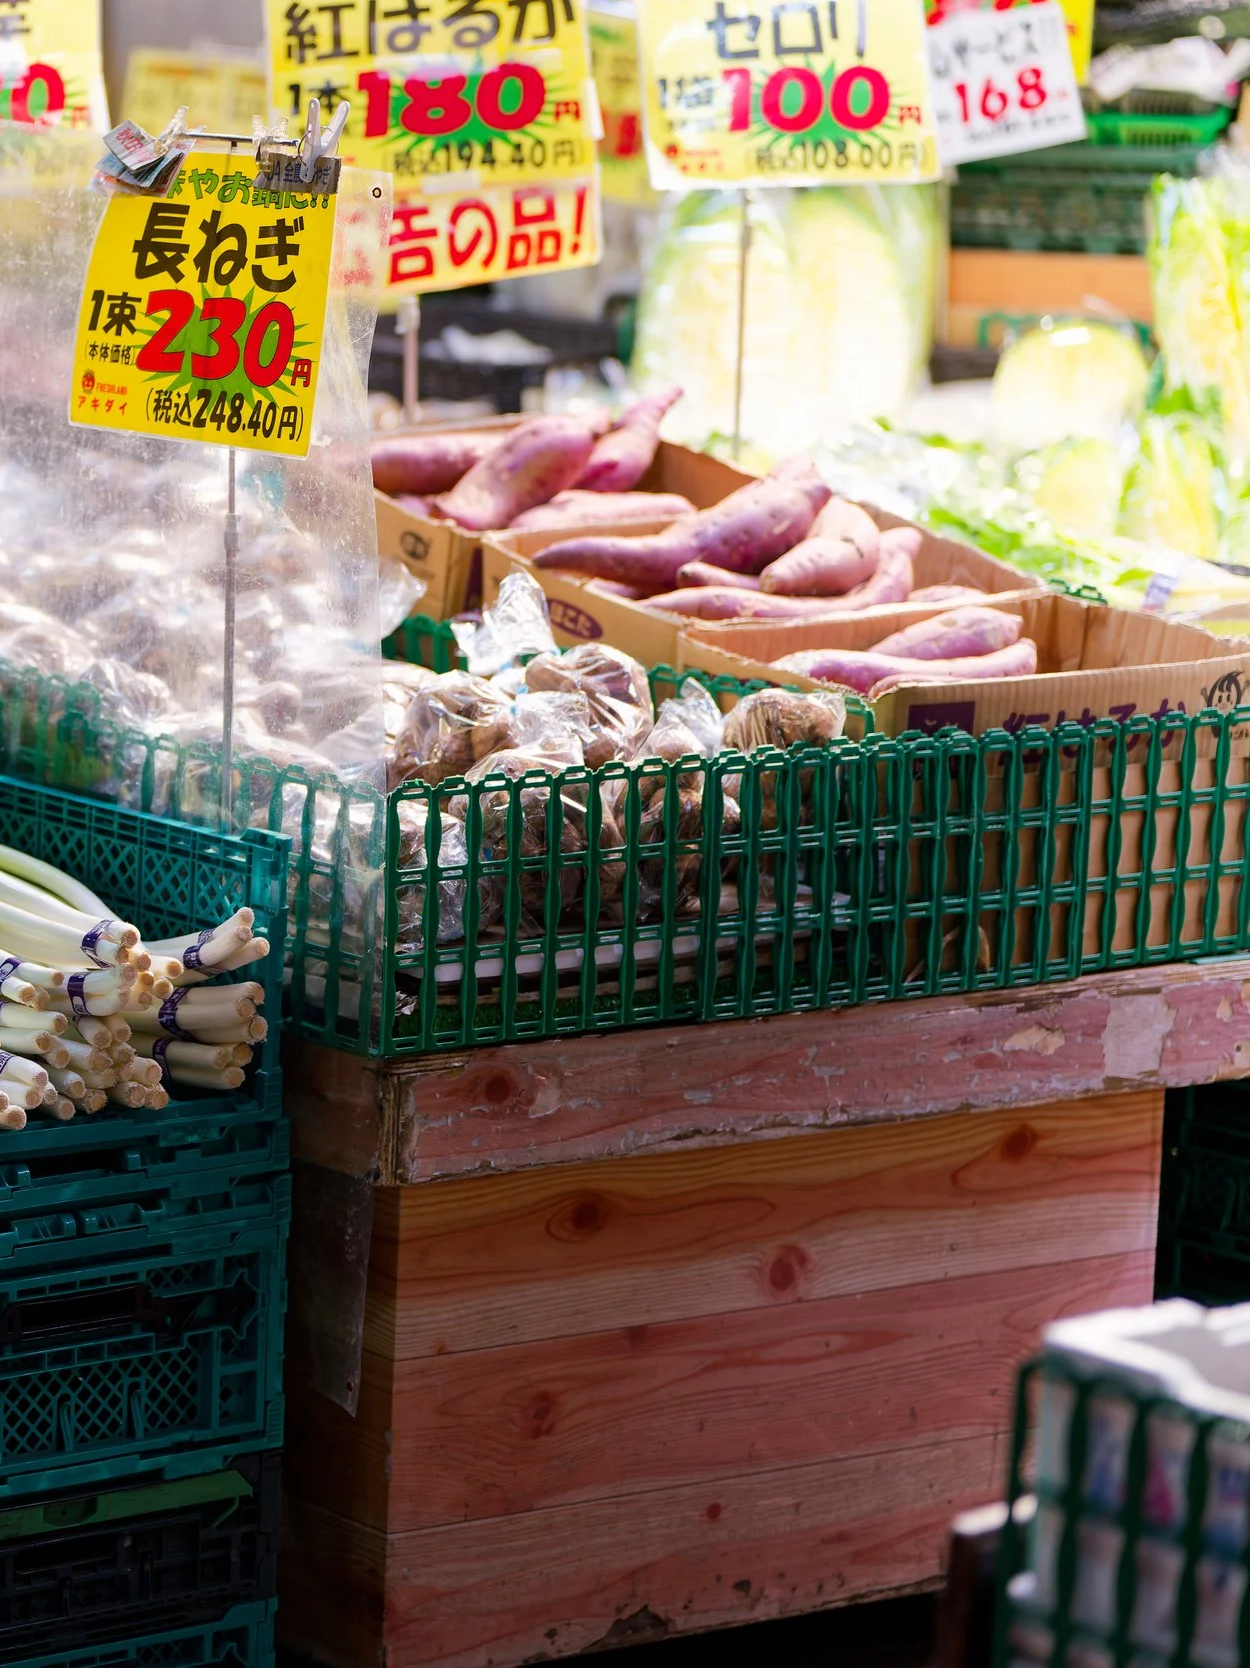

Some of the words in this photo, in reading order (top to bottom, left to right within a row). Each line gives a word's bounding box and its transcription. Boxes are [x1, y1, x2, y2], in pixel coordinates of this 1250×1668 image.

[707, 0, 868, 60] セロリ
[954, 67, 1048, 123] 168
[132, 201, 305, 293] 長ねぎ
[87, 289, 142, 337] 1束
[77, 395, 128, 416] アキダイ
